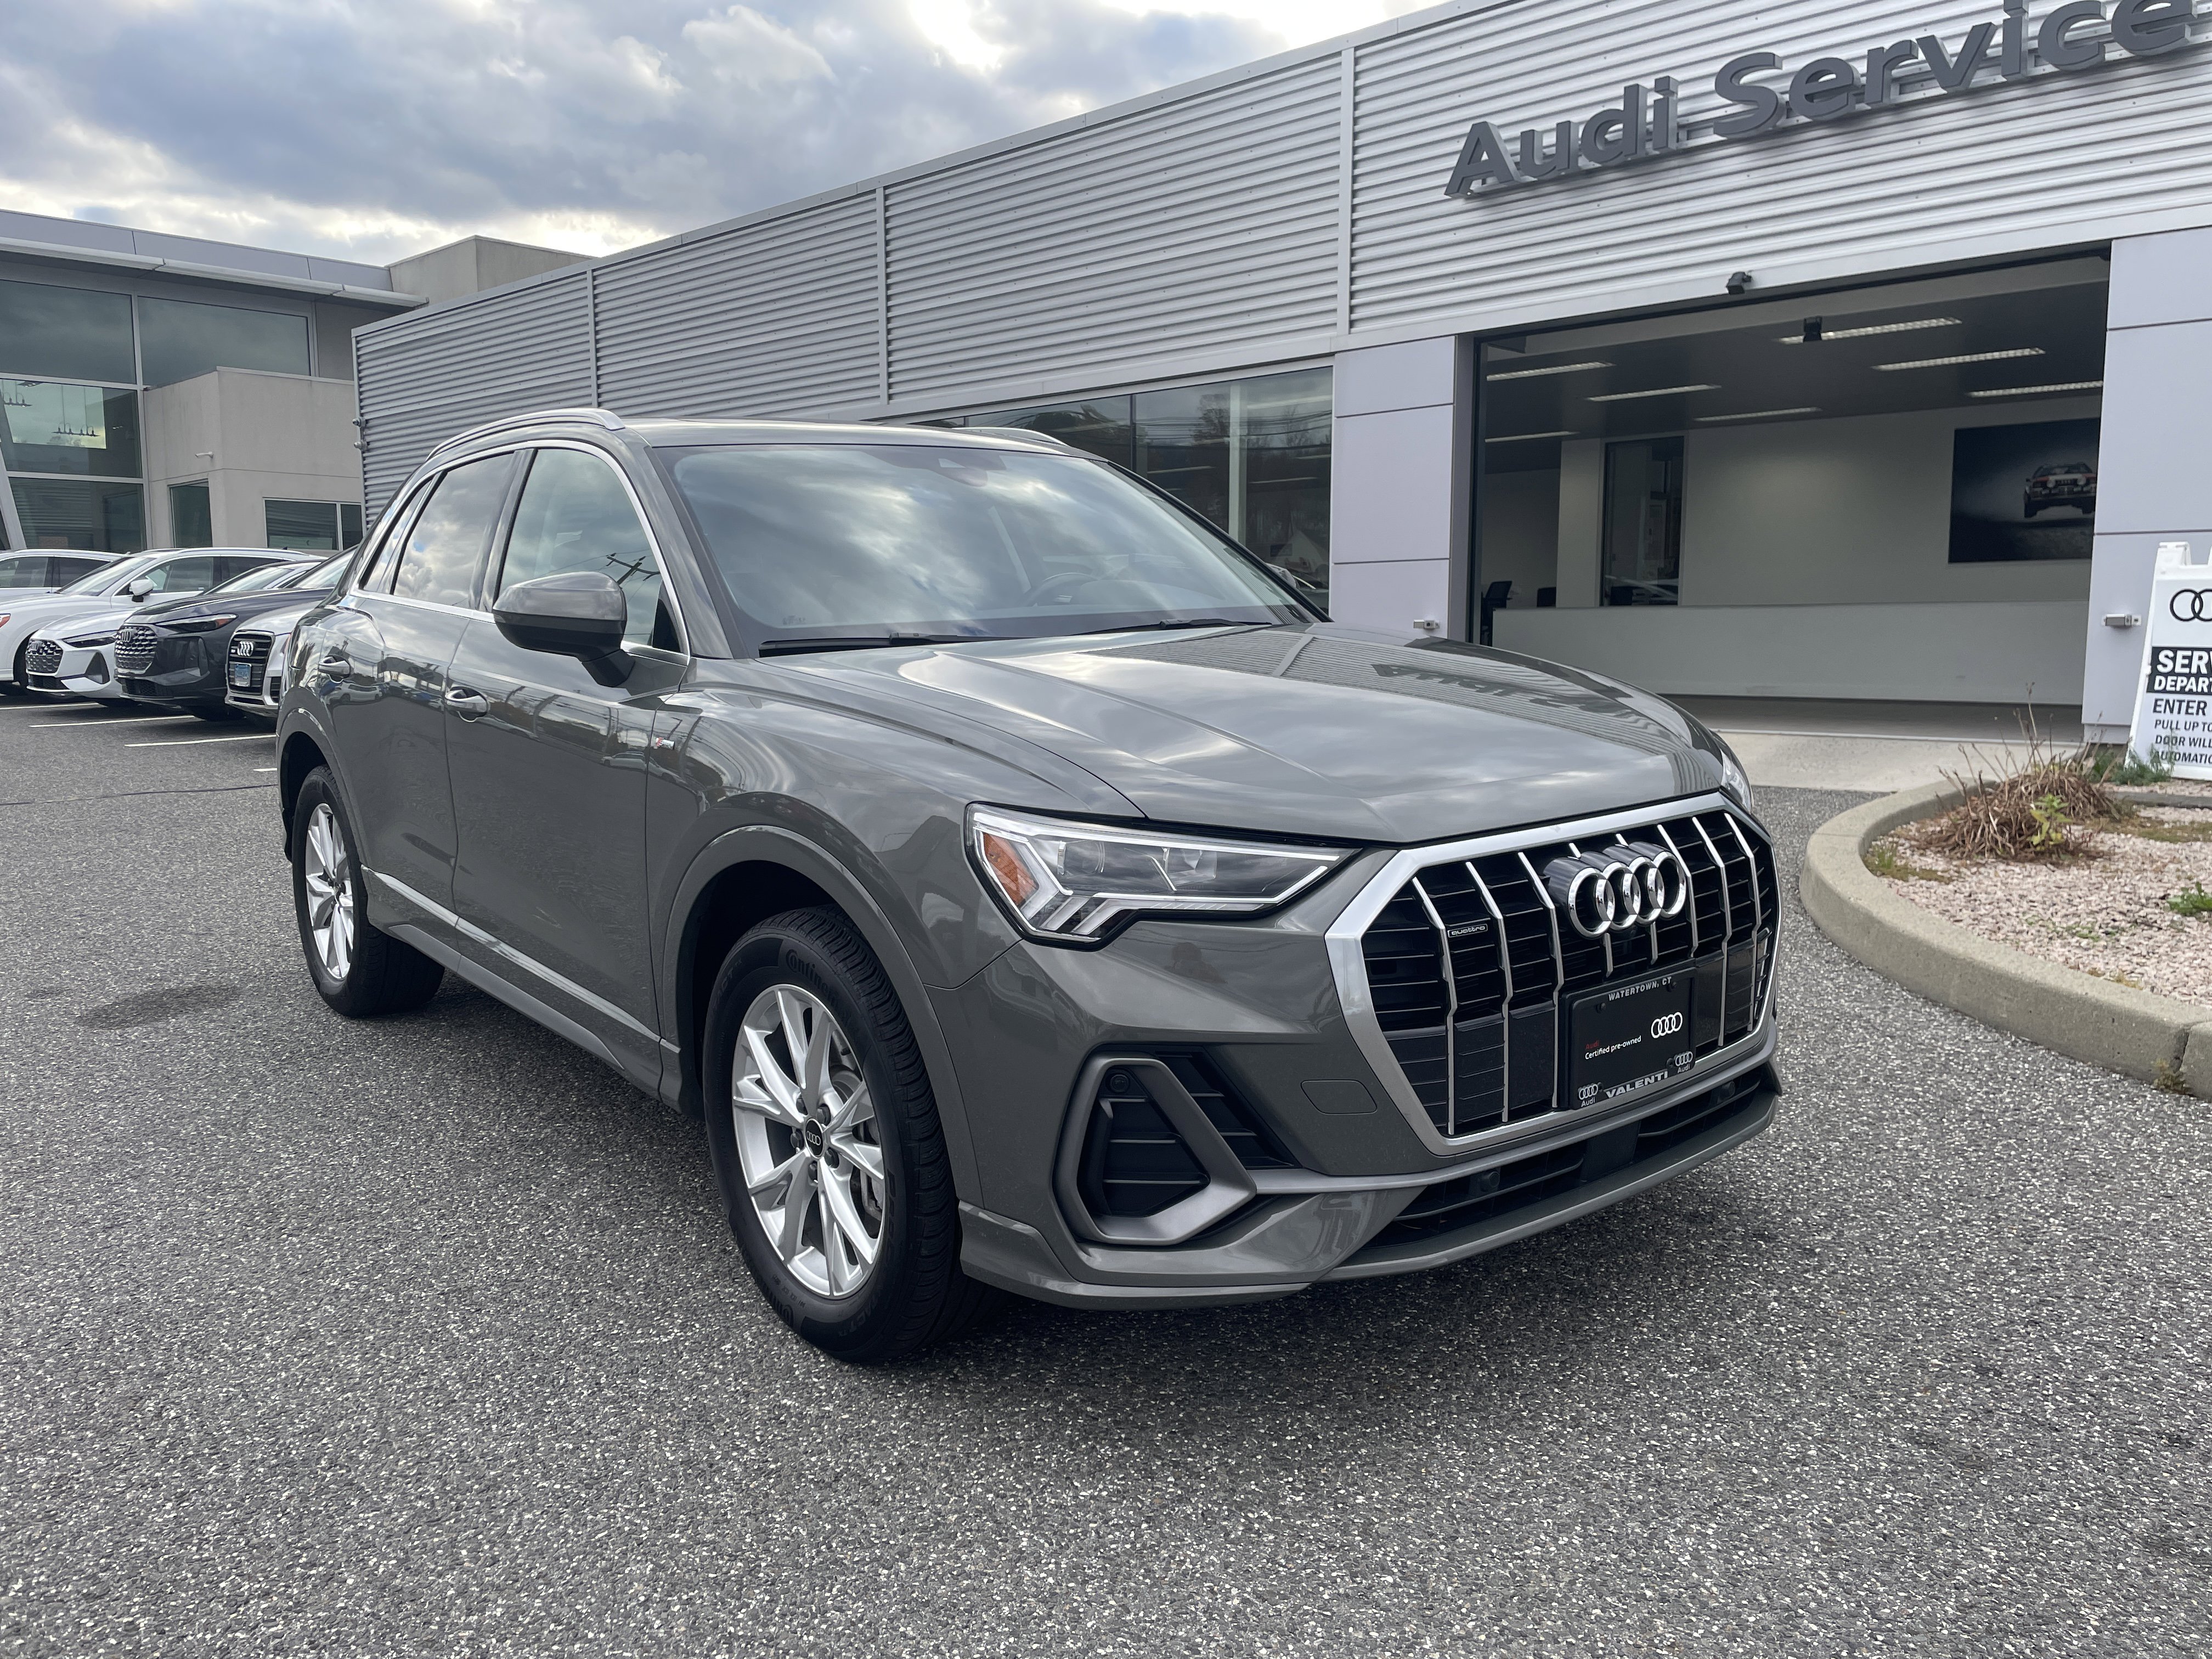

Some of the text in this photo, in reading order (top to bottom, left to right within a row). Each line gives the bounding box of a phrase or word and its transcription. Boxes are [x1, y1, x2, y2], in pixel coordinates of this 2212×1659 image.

[1444, 0, 2196, 198] Audi Service
[2157, 649, 2212, 674] SER
[2153, 698, 2207, 716] ENTER
[2154, 719, 2180, 730] PULL
[2184, 720, 2199, 731] UP
[2155, 735, 2212, 748] DOOR WILL
[1451, 926, 1486, 936] quattro
[1608, 977, 1672, 1001] WATERTOWN, CT
[1585, 1040, 1599, 1049] Audi
[1585, 1035, 1641, 1060] Certified pre-owned
[1677, 1064, 1690, 1074] Audi
[1606, 1070, 1668, 1098] VALENTI
[1581, 1098, 1595, 1108] Audi
